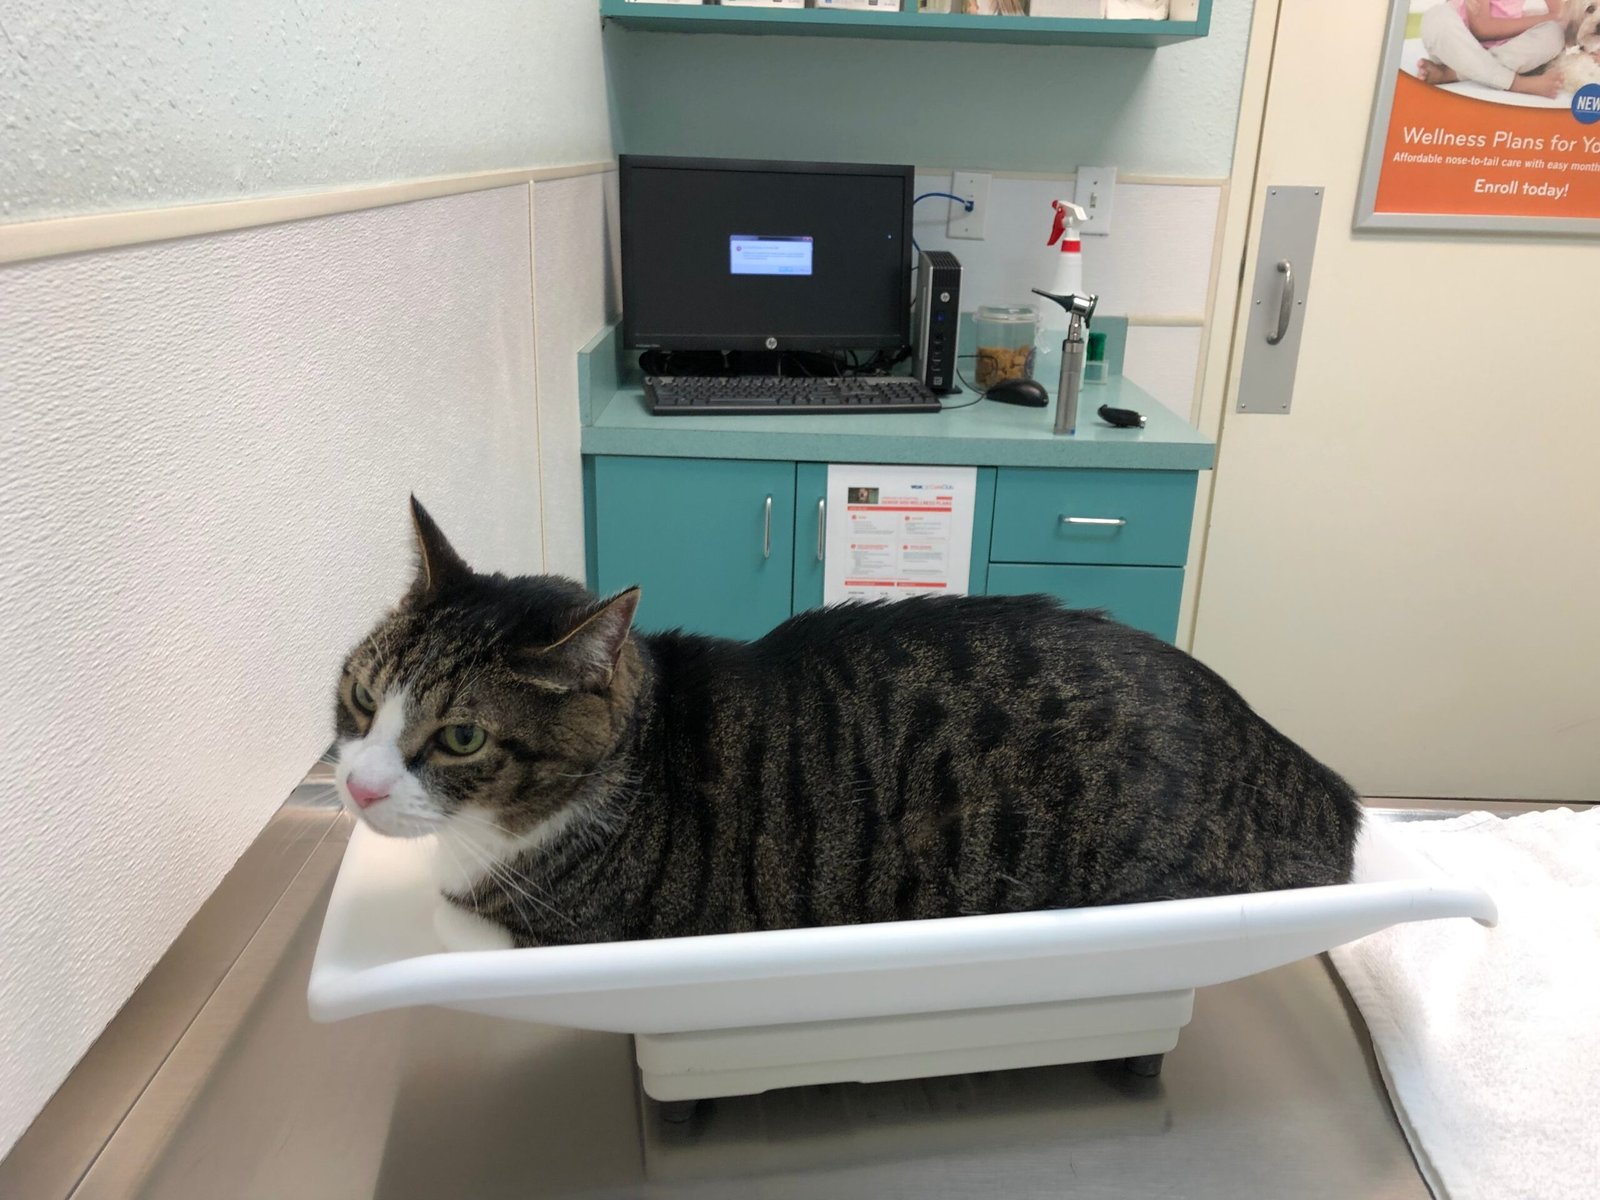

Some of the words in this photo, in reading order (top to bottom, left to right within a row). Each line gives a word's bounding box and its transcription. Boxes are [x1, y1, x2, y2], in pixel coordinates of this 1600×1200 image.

[1403, 127, 1486, 147] Wellness
[1493, 131, 1544, 150] Plans
[1551, 135, 1577, 152] for
[1393, 152, 1443, 164] Affordable
[1446, 154, 1499, 167] nose-to-tail
[1501, 158, 1522, 168] care
[1525, 158, 1545, 169] with
[1547, 162, 1568, 172] easy
[1474, 178, 1518, 195] Enroll
[1522, 182, 1569, 200] today!
